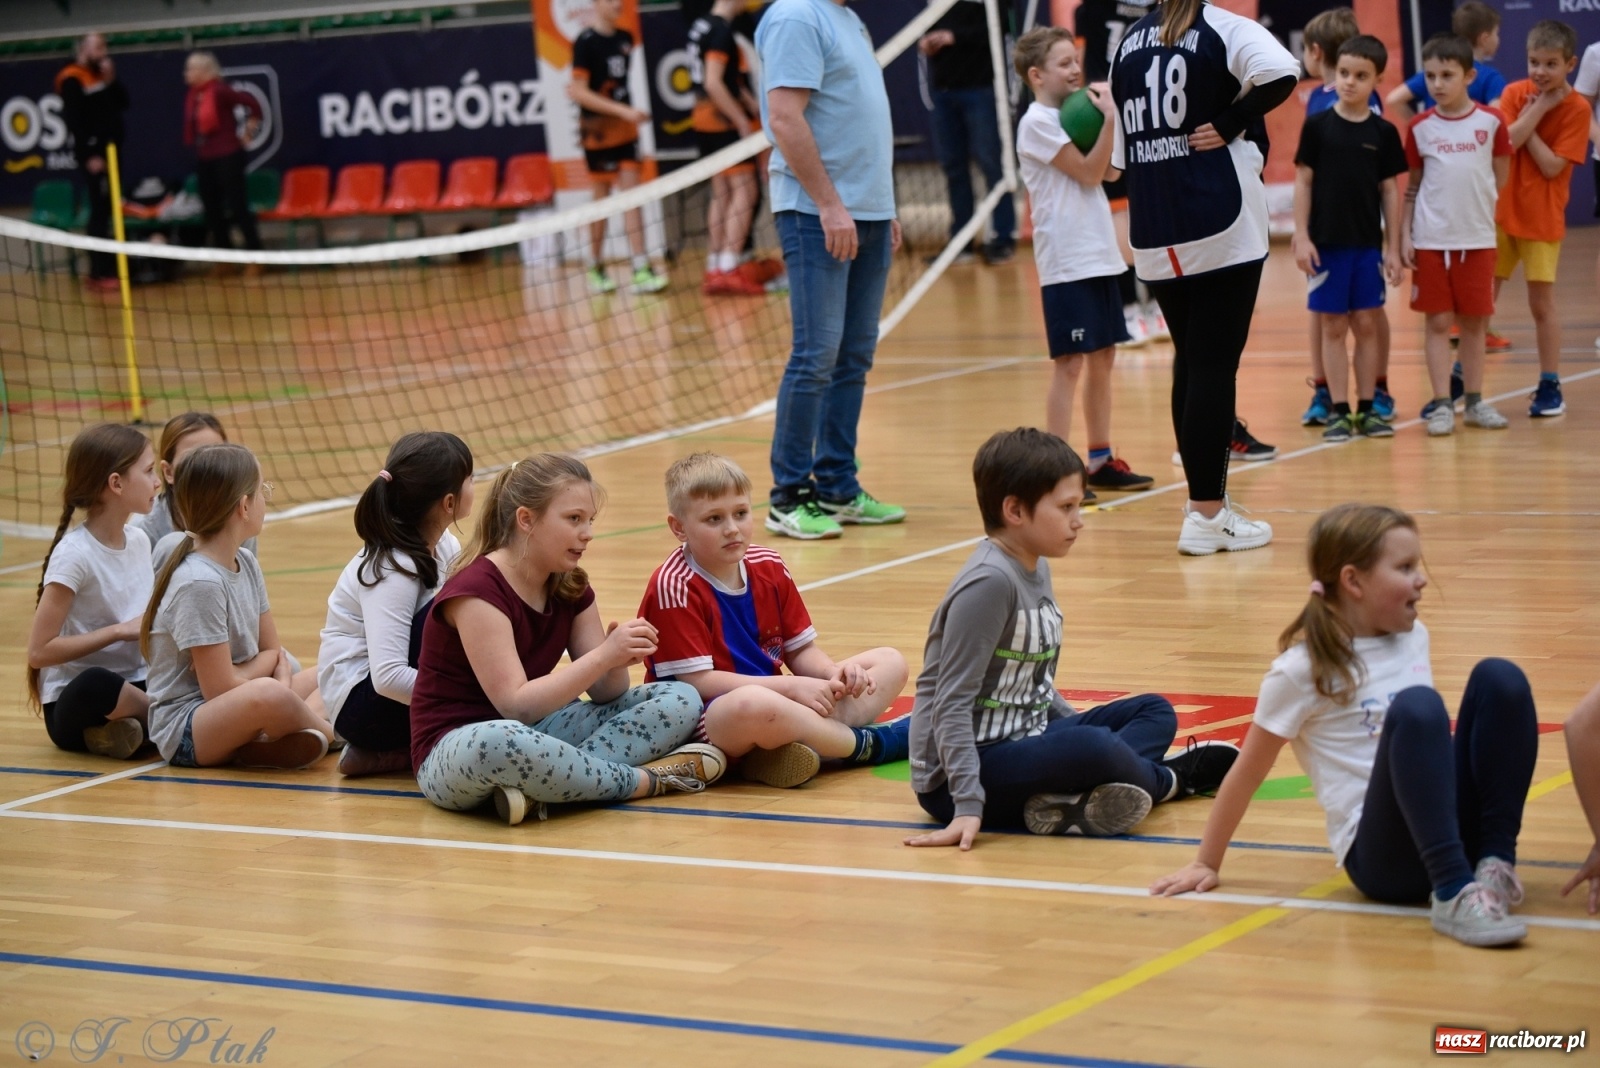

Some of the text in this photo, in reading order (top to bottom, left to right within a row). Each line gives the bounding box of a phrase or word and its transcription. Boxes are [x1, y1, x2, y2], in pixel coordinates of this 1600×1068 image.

[319, 69, 546, 138] RACIBÓRZ
[1123, 54, 1188, 135] nr 18
[1437, 142, 1477, 154] POLSKA
